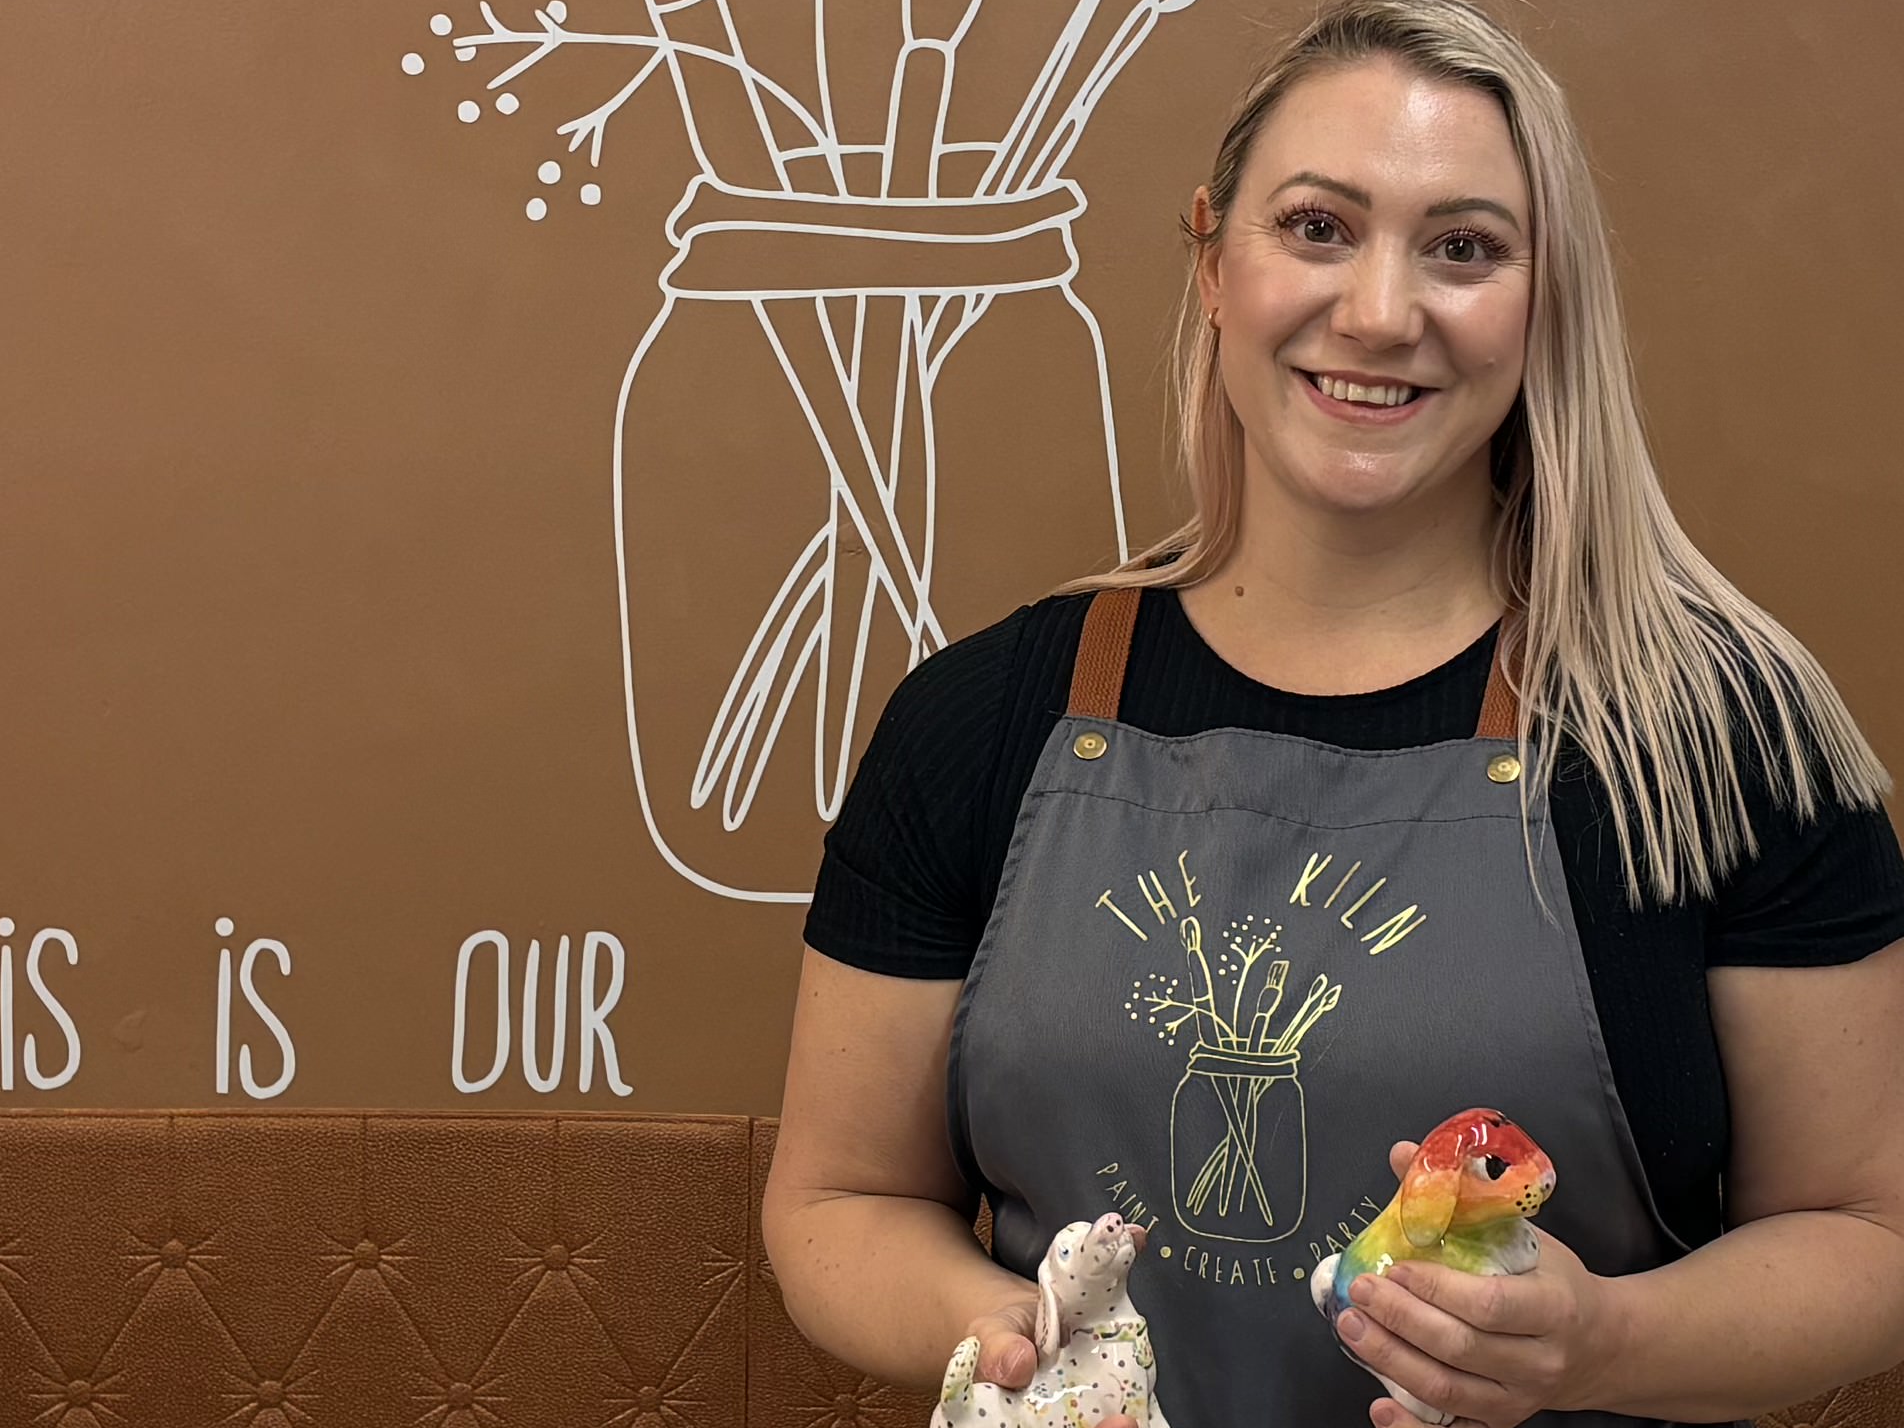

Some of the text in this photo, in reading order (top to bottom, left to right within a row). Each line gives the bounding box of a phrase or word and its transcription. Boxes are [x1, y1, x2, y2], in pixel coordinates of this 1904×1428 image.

[1095, 849, 1428, 956] THE KILN
[452, 929, 635, 1098] OUR
[1096, 1162, 1160, 1234] PAINT
[1183, 1245, 1277, 1286] CREATE
